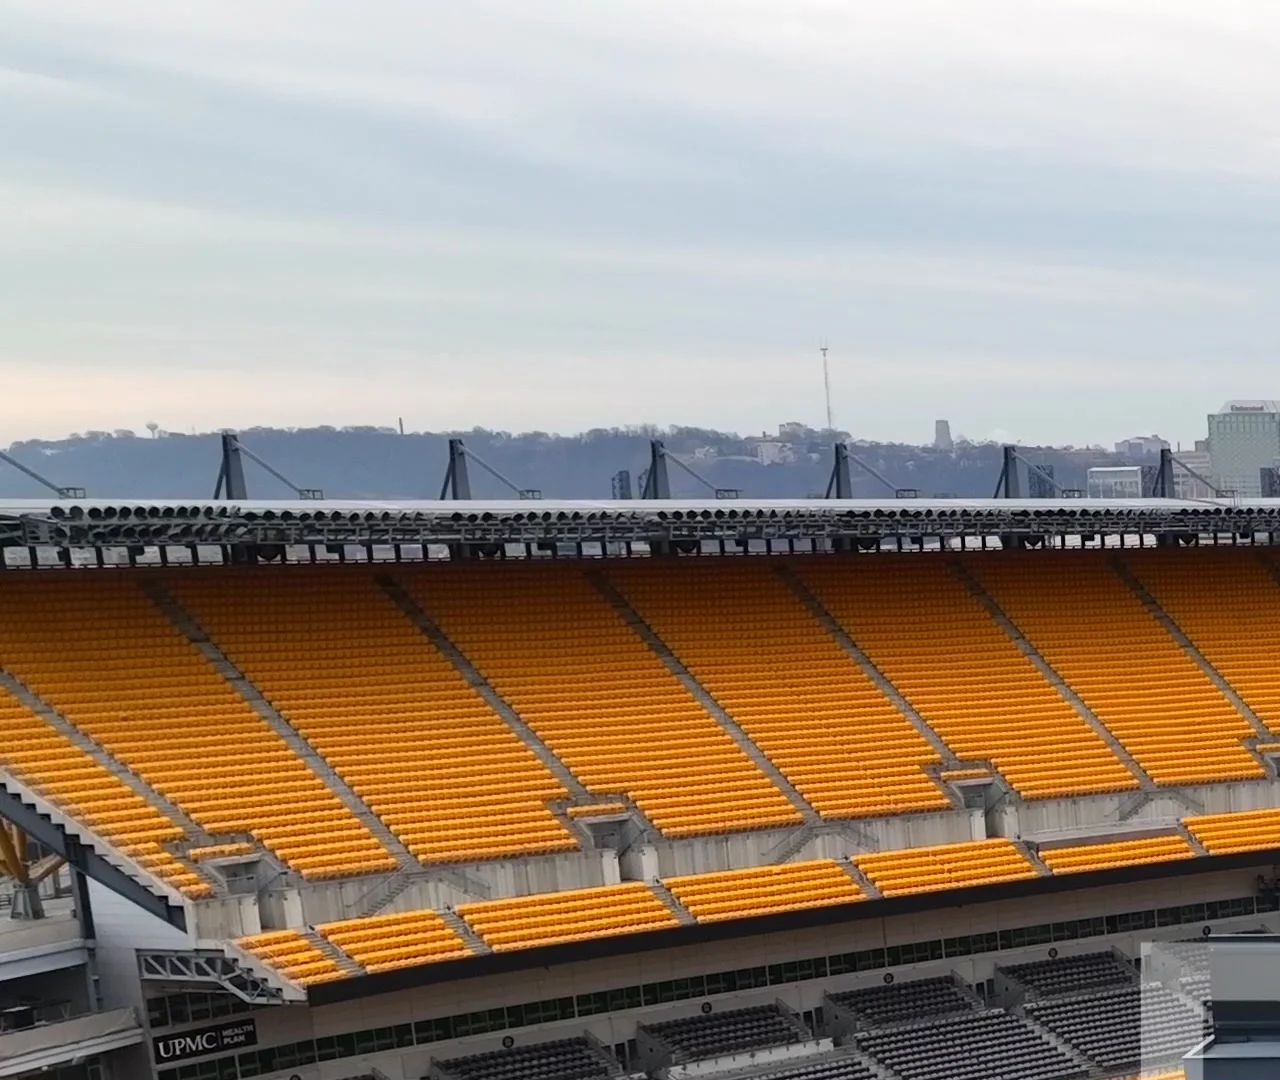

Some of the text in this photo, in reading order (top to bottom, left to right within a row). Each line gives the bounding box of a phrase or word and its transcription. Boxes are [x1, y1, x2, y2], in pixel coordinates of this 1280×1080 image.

[158, 1024, 254, 1058] UPMC HEALTH
[223, 1034, 246, 1044] PLAN
